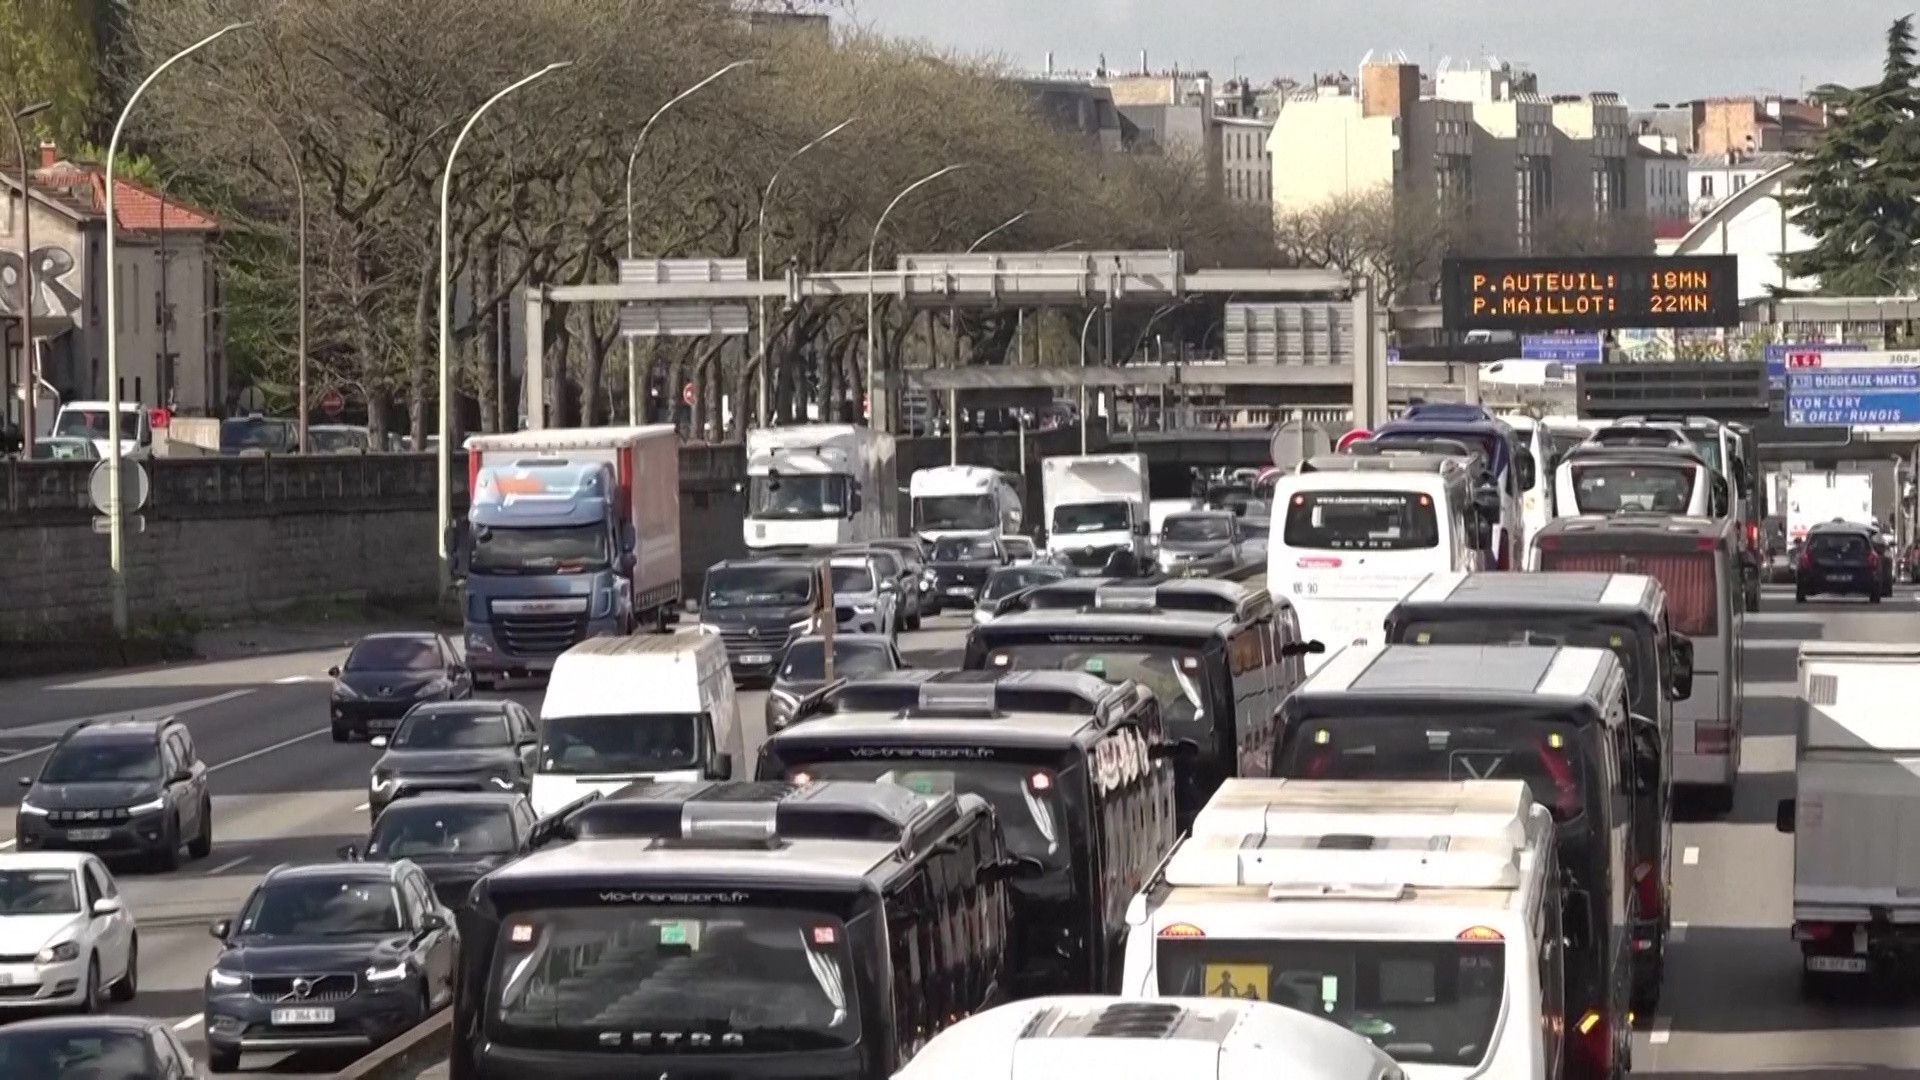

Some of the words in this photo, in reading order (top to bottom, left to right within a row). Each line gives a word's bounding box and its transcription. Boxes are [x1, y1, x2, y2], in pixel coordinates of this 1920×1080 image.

[1473, 273, 1615, 292] P.AUTEUIL:
[1651, 272, 1708, 290] 18MN
[1473, 296, 1615, 315] P.MAILLOT:
[1650, 295, 1708, 313] 22MN
[1815, 374, 1917, 387] BORDEAUX-NANTES
